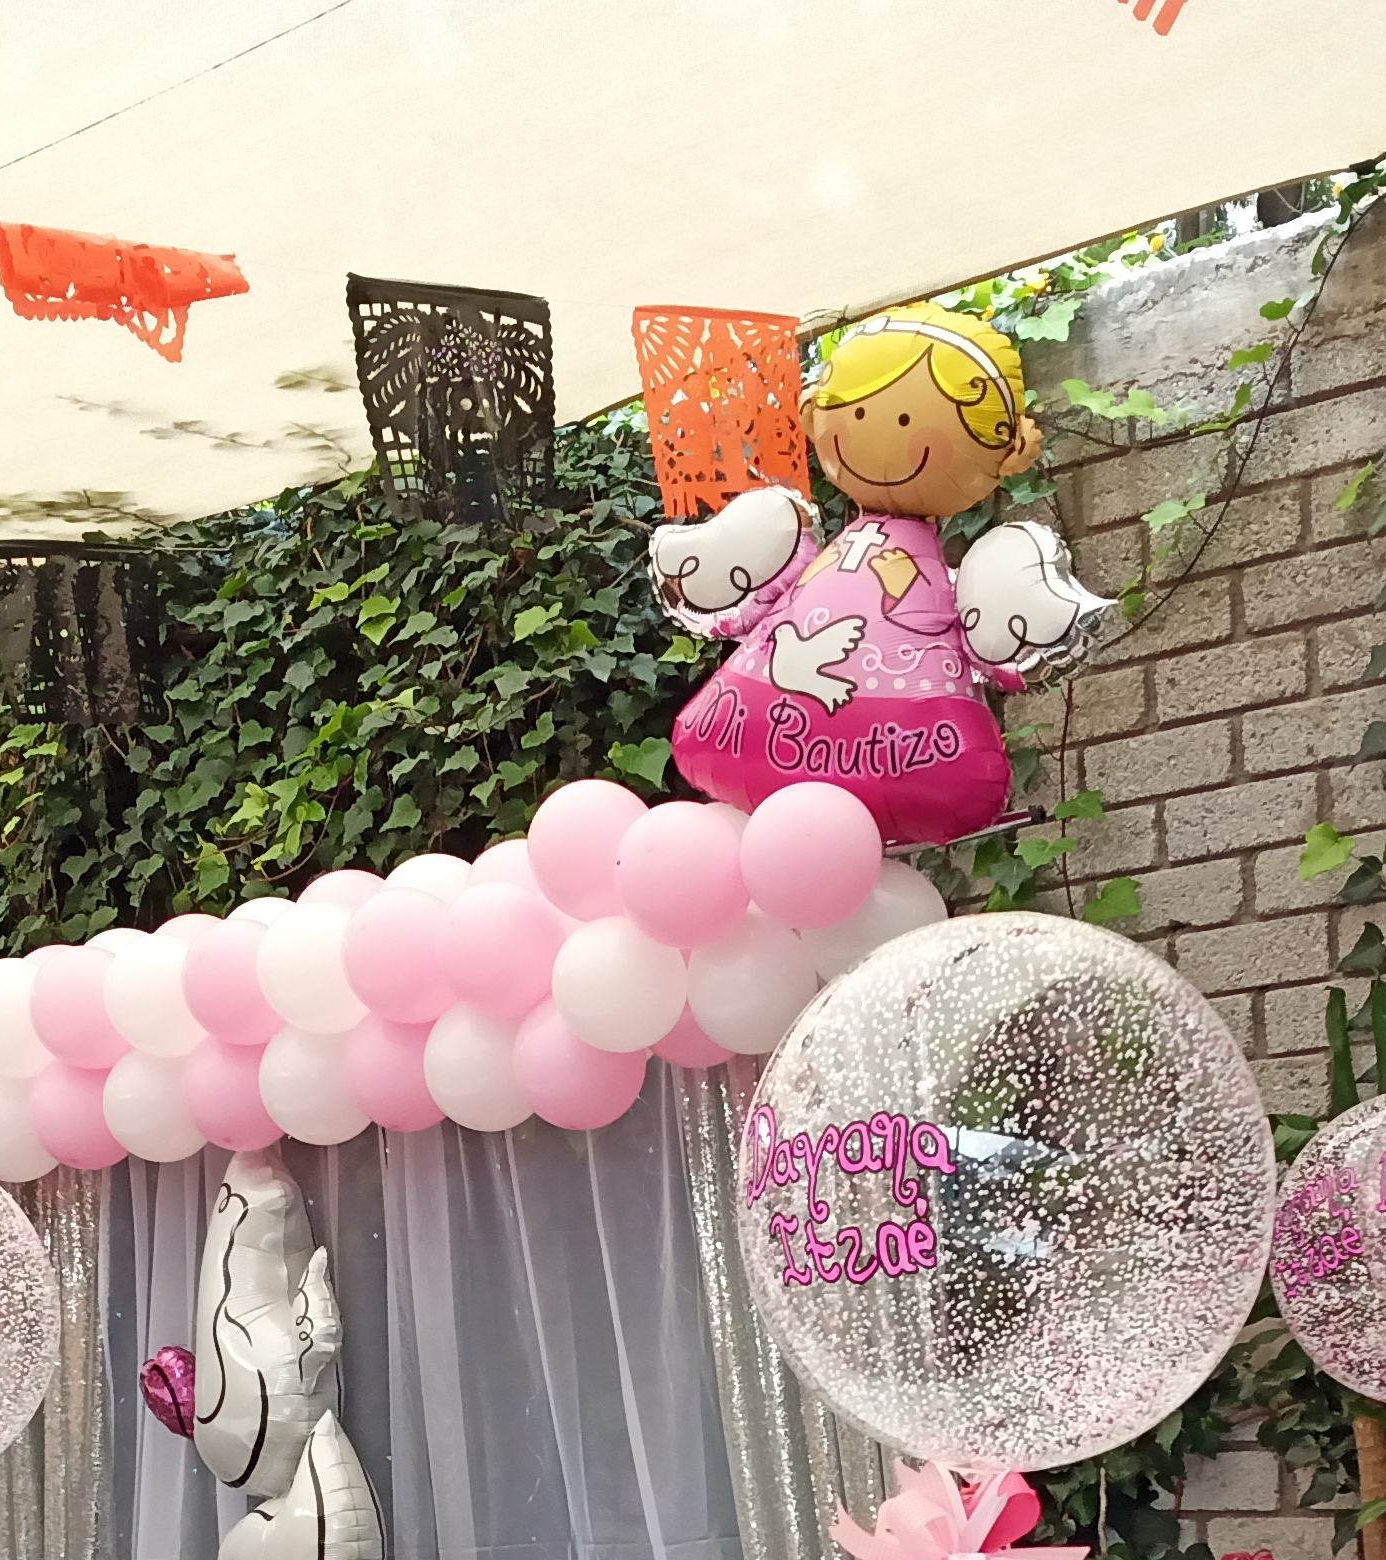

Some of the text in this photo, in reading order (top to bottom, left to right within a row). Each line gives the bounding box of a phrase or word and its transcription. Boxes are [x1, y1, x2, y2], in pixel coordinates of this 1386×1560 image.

[680, 679, 962, 777] Mi Bautizo
[746, 1104, 957, 1223] Dayana
